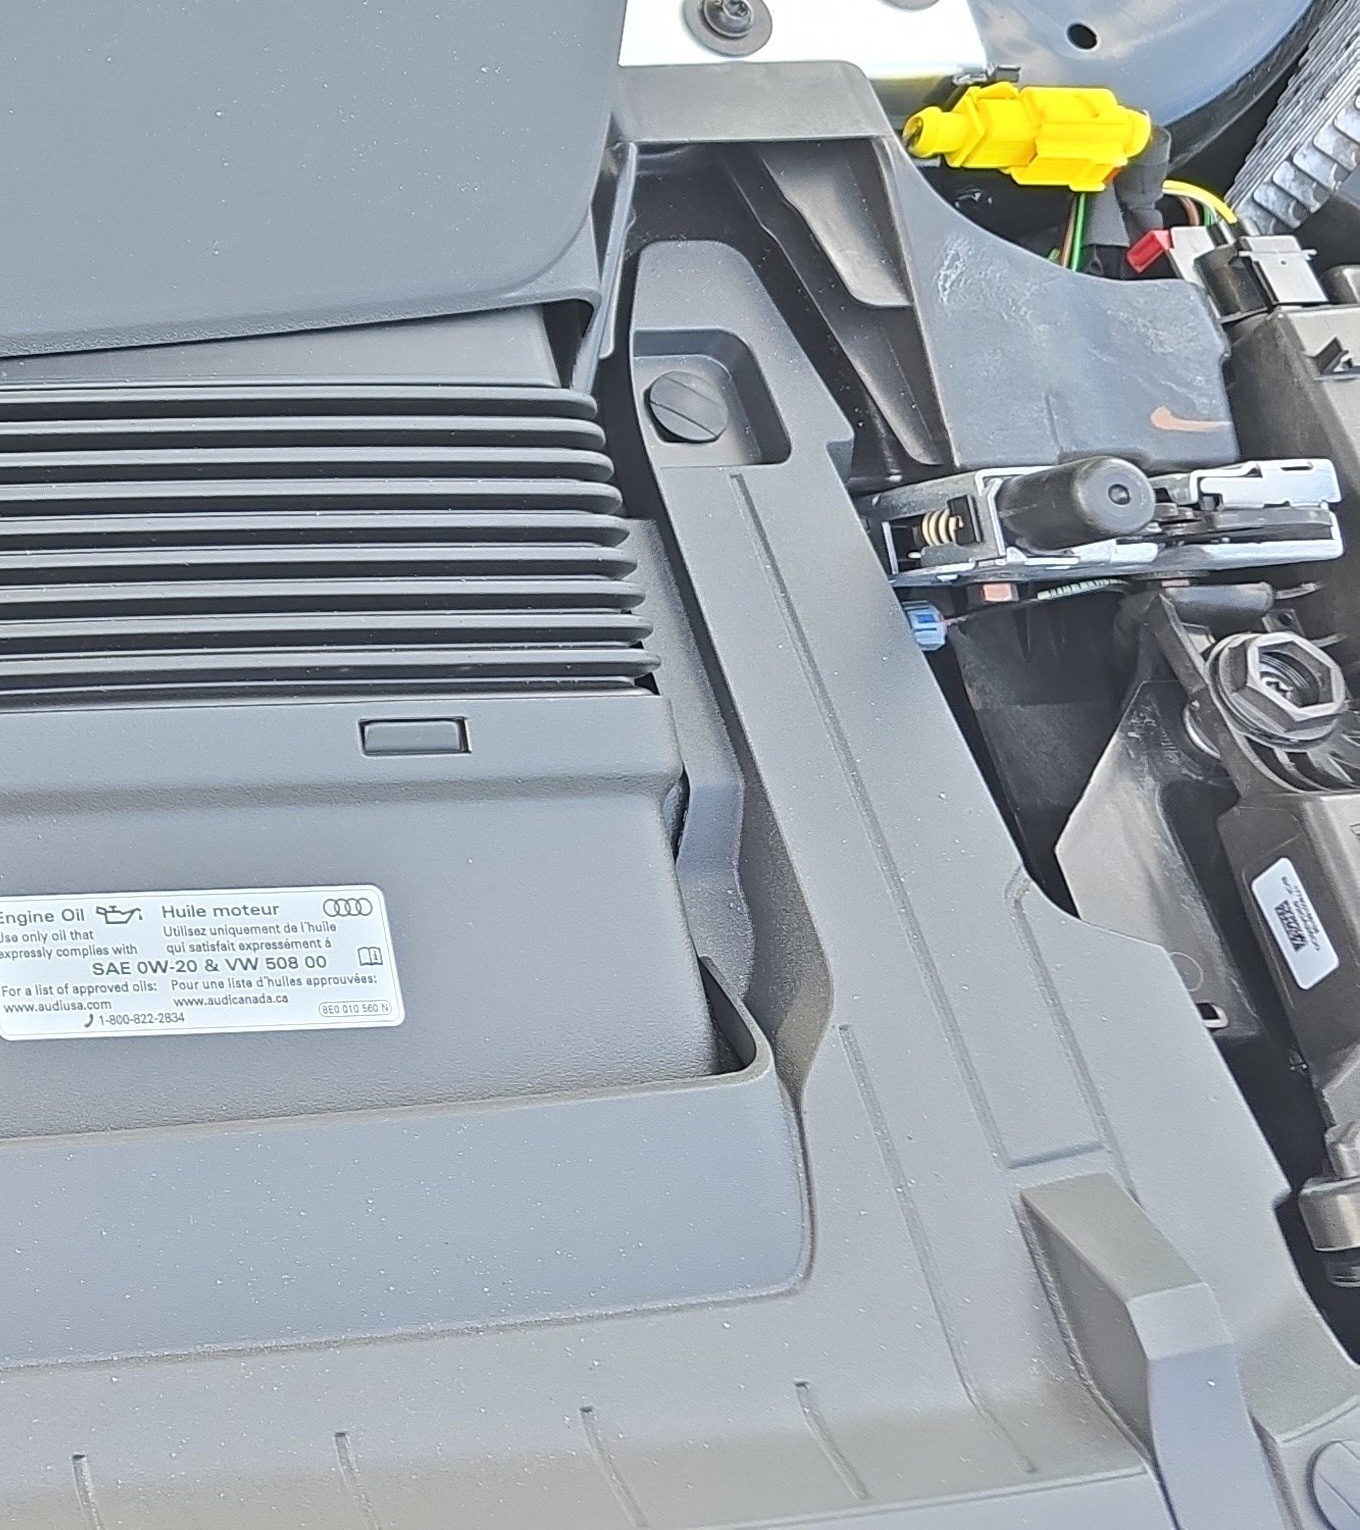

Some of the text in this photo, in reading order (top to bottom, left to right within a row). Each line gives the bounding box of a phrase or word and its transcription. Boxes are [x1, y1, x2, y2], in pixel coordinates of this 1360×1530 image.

[61, 908, 84, 921] Oil
[161, 904, 279, 918] Huile moteur
[21, 930, 47, 943] only
[51, 929, 66, 941] oil
[69, 928, 94, 940] that
[162, 925, 207, 937] Utilisez
[209, 923, 281, 937] uniquement
[283, 922, 297, 933] de
[55, 944, 109, 958] complies
[111, 943, 137, 955] with
[166, 941, 185, 954] qui
[188, 939, 236, 952] satisfait
[238, 937, 322, 952] expressément
[92, 955, 326, 975] SAE 0W-20 & VW 508 00
[1, 980, 157, 996] For a list of approved oils:
[170, 979, 199, 990] Pour
[201, 980, 224, 989] une
[227, 977, 252, 988] liste
[305, 973, 377, 988] approuvées:
[3, 999, 112, 1013] www.audiusa.com
[172, 992, 288, 1006] www.audicanada.ca
[98, 1011, 184, 1025] 1-800-822-2834
